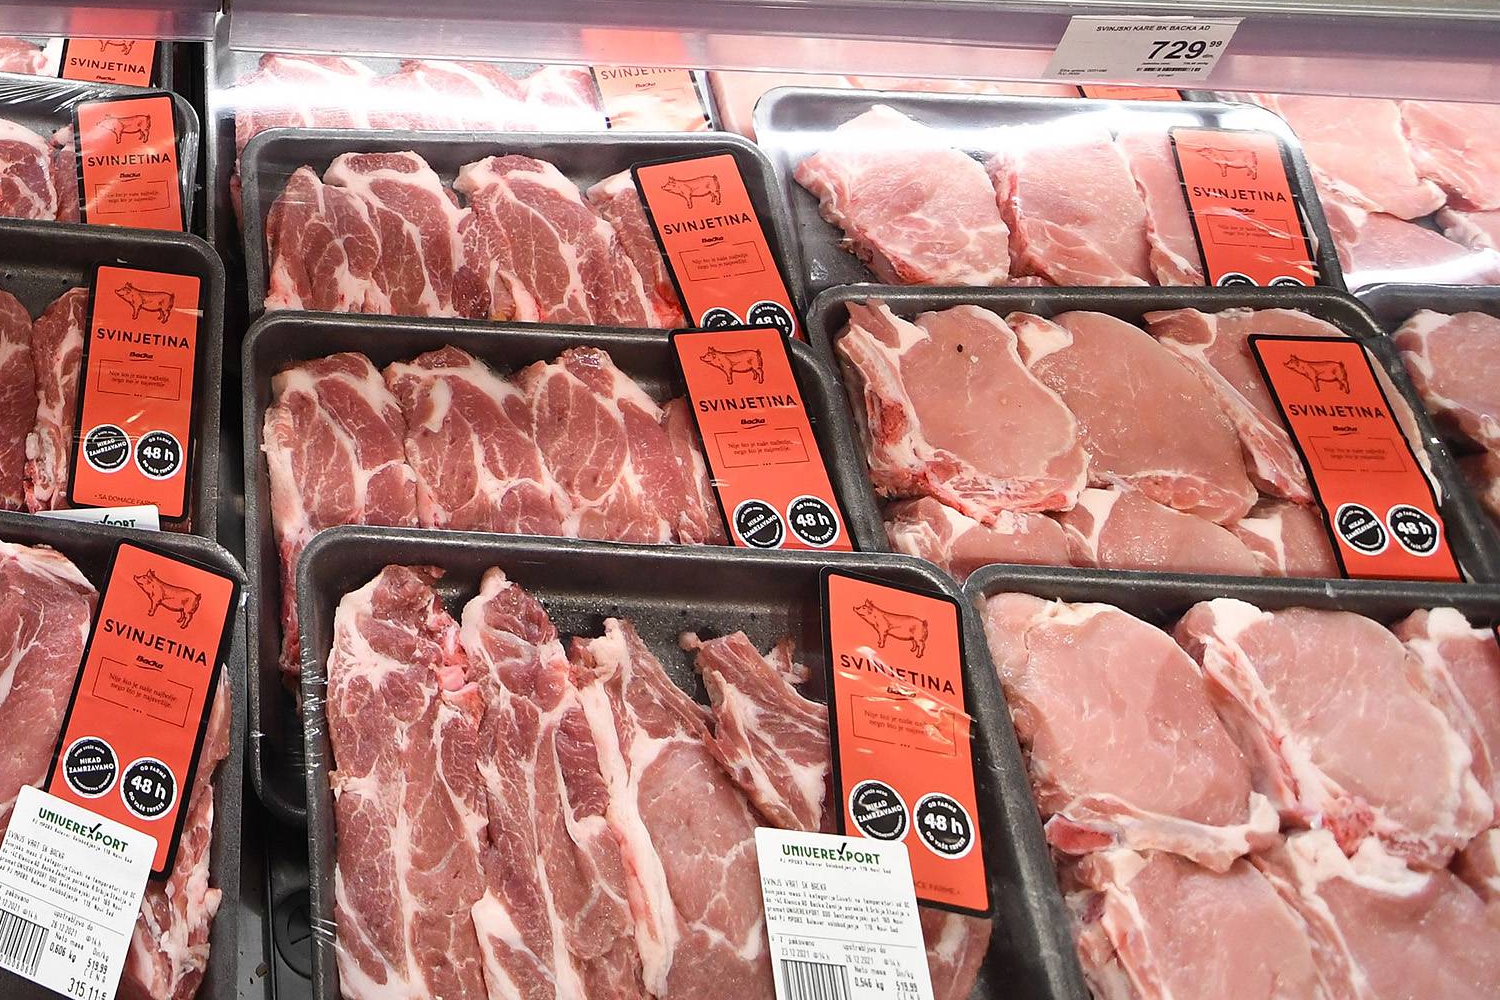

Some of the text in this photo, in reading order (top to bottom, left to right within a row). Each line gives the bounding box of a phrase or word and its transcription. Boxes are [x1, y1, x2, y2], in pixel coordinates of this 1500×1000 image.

[1148, 41, 1206, 59] 729
[70, 57, 146, 74] SVINJETINA
[87, 152, 171, 167] SVINJETINA
[1193, 186, 1287, 203] SVINJETINA
[663, 212, 752, 235] SVINJETINA
[97, 328, 190, 349] SVINJETINA
[699, 394, 797, 413] SVINJETINA
[1288, 404, 1385, 419] SVINJETINA
[142, 446, 174, 461] 48 h
[796, 513, 830, 528] 48 h
[1399, 522, 1433, 535] 48 h
[103, 618, 208, 667] SVINJETINA
[840, 654, 955, 696] SVINJETINA
[69, 762, 114, 773] ZAMRZAVANO
[80, 755, 102, 766] NIKAD
[131, 776, 166, 799] 48 h
[858, 805, 902, 822] ZAMRZAVANO
[866, 800, 887, 811] NIKAD
[38, 807, 129, 854] UNIVEREXPORT
[924, 813, 964, 835] 48 h
[782, 844, 880, 865] UNIVEREXPORT
